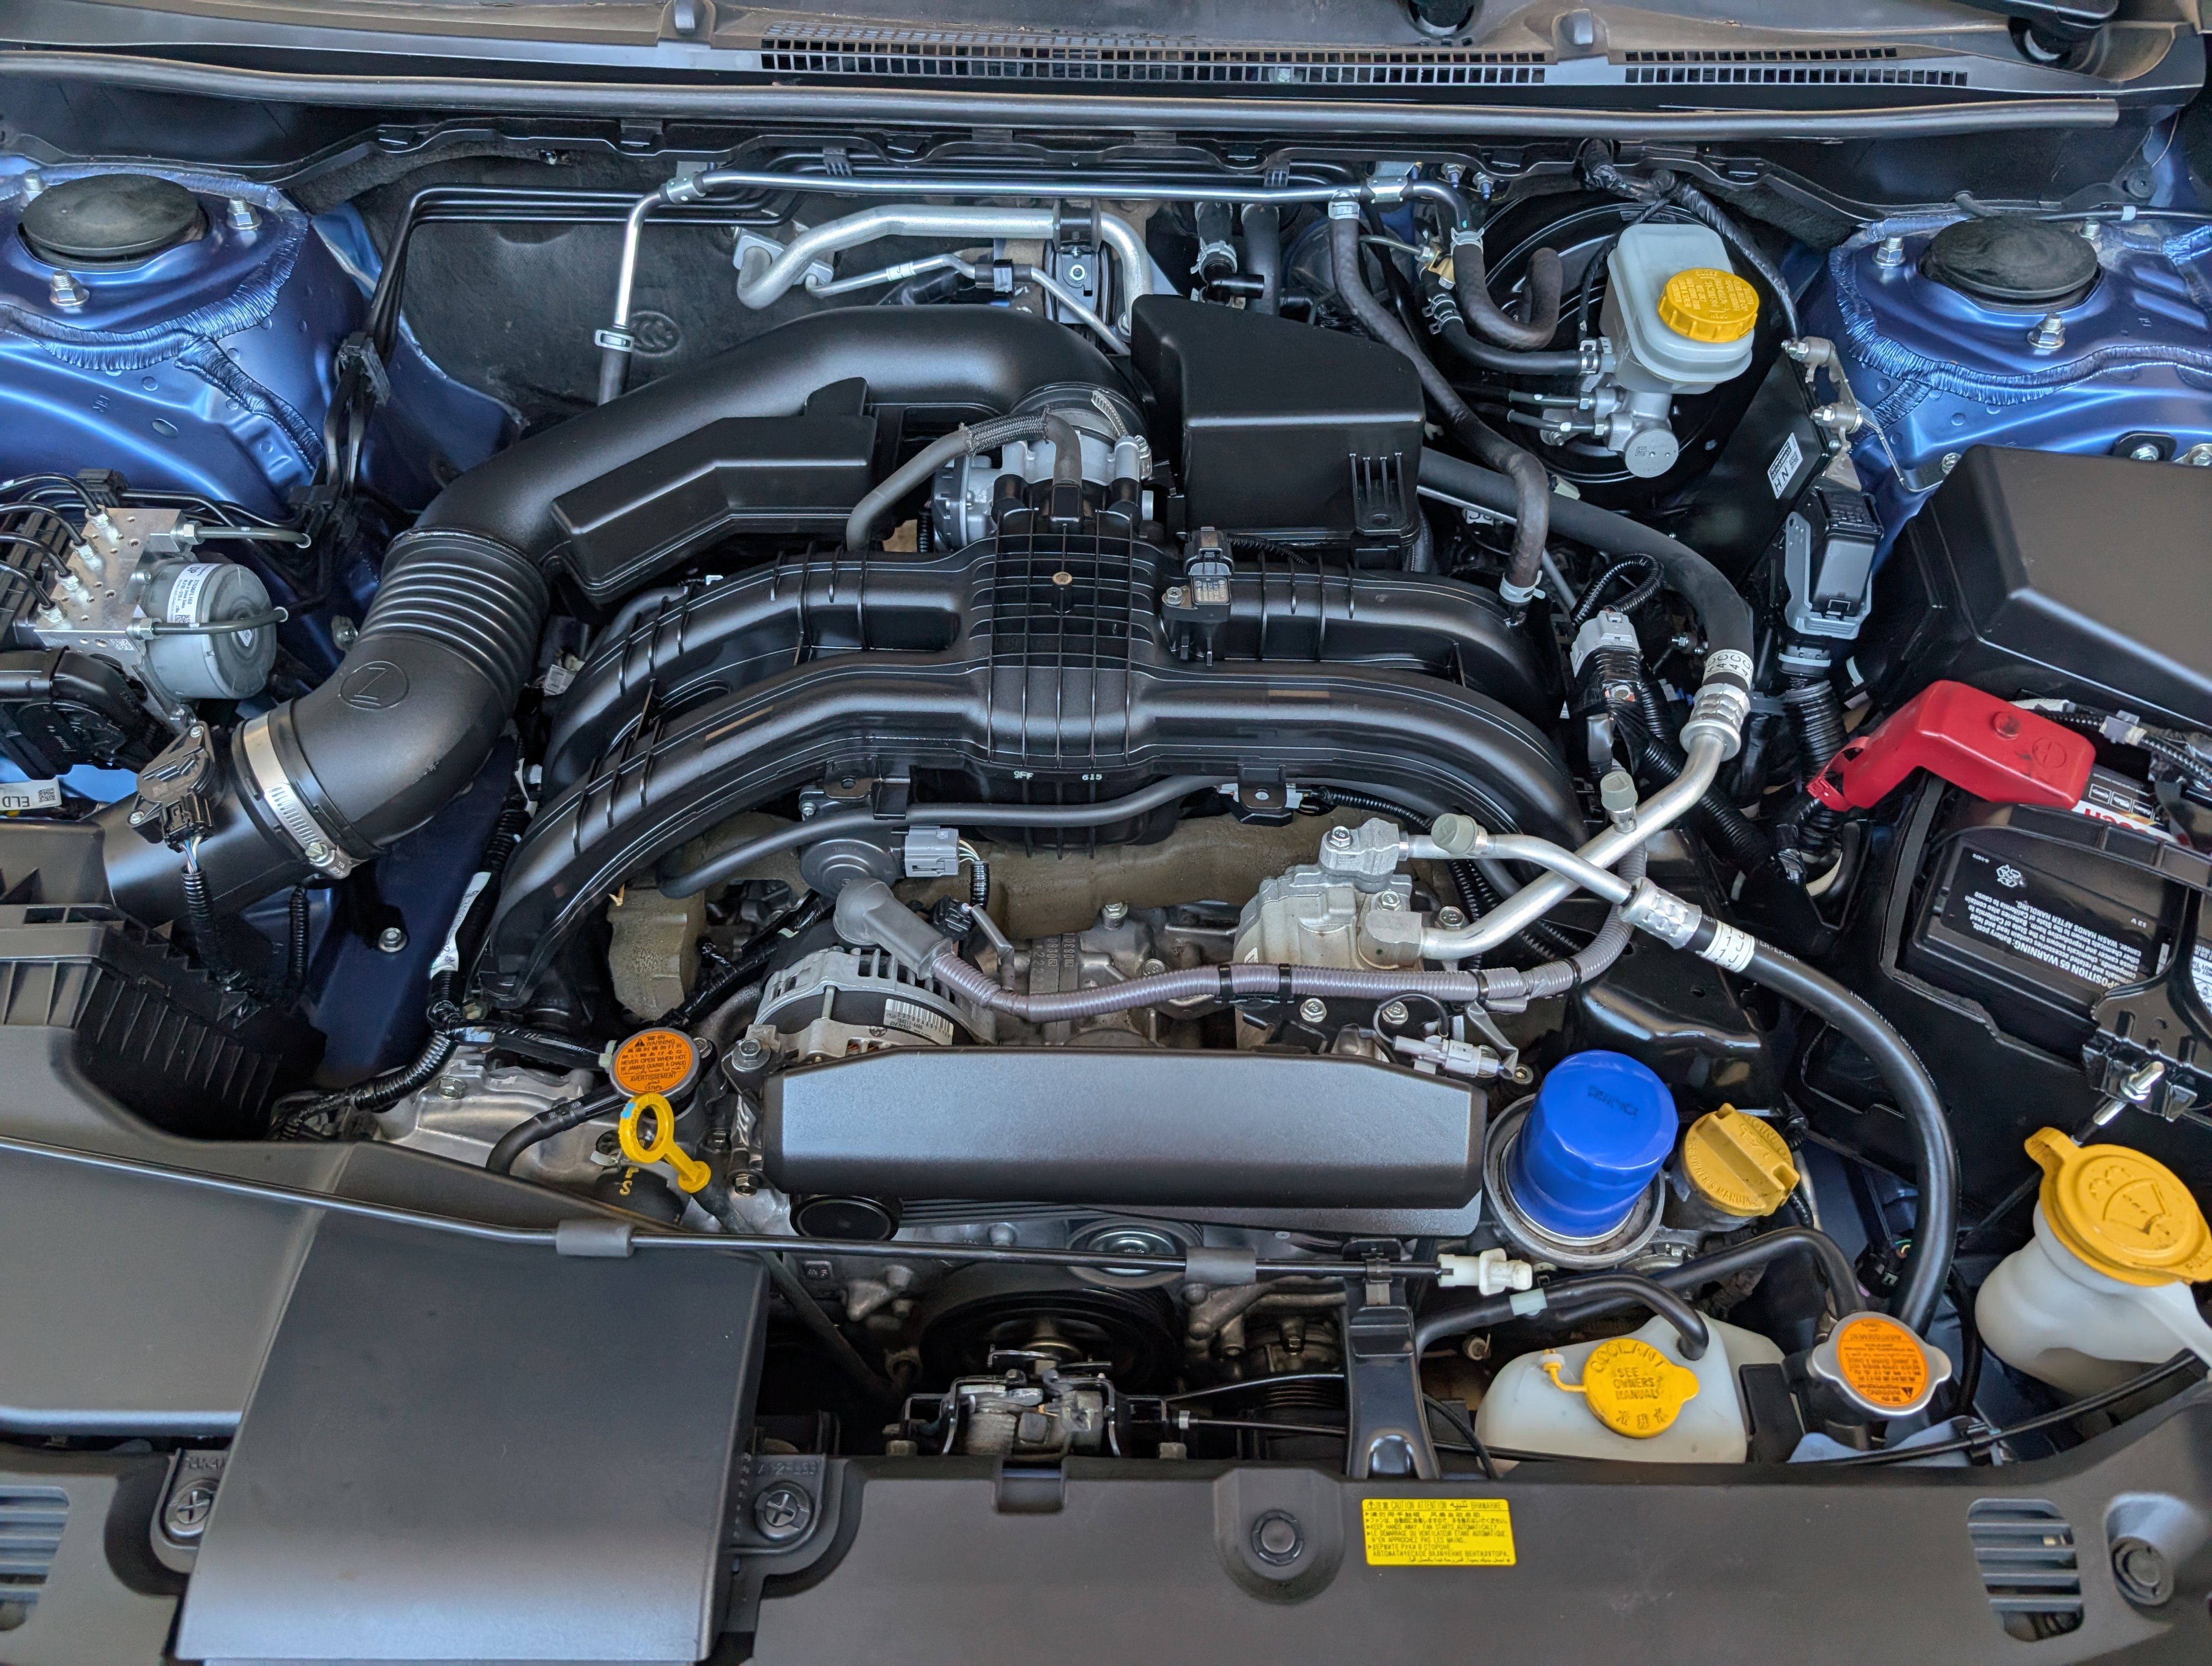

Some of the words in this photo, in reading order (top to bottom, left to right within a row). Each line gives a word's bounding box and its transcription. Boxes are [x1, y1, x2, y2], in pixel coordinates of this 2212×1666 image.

[1963, 894, 1988, 909] contain
[1973, 889, 1994, 904] cause
[1991, 897, 2001, 906] to
[1967, 902, 1976, 912] to
[1986, 903, 2002, 915] also
[1998, 900, 2029, 919] California
[1969, 912, 1985, 924] lead
[1974, 906, 2005, 924] California
[1999, 909, 2029, 926] Batteries
[2028, 913, 2037, 921] of
[2035, 915, 2053, 928] State
[1983, 918, 1997, 929] and
[2003, 918, 2012, 927] of
[2010, 921, 2029, 934] State
[2050, 914, 2074, 930] AFTER
[2052, 922, 2064, 933] the
[1995, 923, 2011, 935] lead
[2027, 928, 2040, 939] the
[2062, 927, 2071, 936] to
[2072, 924, 2098, 939] HANDS
[2009, 928, 2034, 945] contain
[2037, 932, 2047, 942] to
[2045, 935, 2067, 950] known
[2046, 928, 2086, 950] reproductive
[2069, 930, 2092, 945] known
[2096, 933, 2119, 948] WASH
[2010, 938, 2061, 966] WARNING:
[2032, 938, 2070, 960] accessories
[2066, 944, 2099, 964] chemicals
[2085, 944, 2098, 955] and
[2090, 939, 2123, 958] chemicals
[2068, 954, 2093, 970] related
[2097, 949, 2120, 964] cancer
[2057, 958, 2072, 971] 65
[2091, 963, 2105, 975] and
[2118, 958, 2139, 972] cause
[629, 1072, 677, 1082] AVERTISSEMENT
[1590, 1342, 1668, 1373] COOLANT
[1617, 1367, 1639, 1377] SEE
[1615, 1388, 1659, 1400] MANUAL
[1391, 1501, 1414, 1509] CAUTION
[1417, 1501, 1446, 1509] ATTENTION
